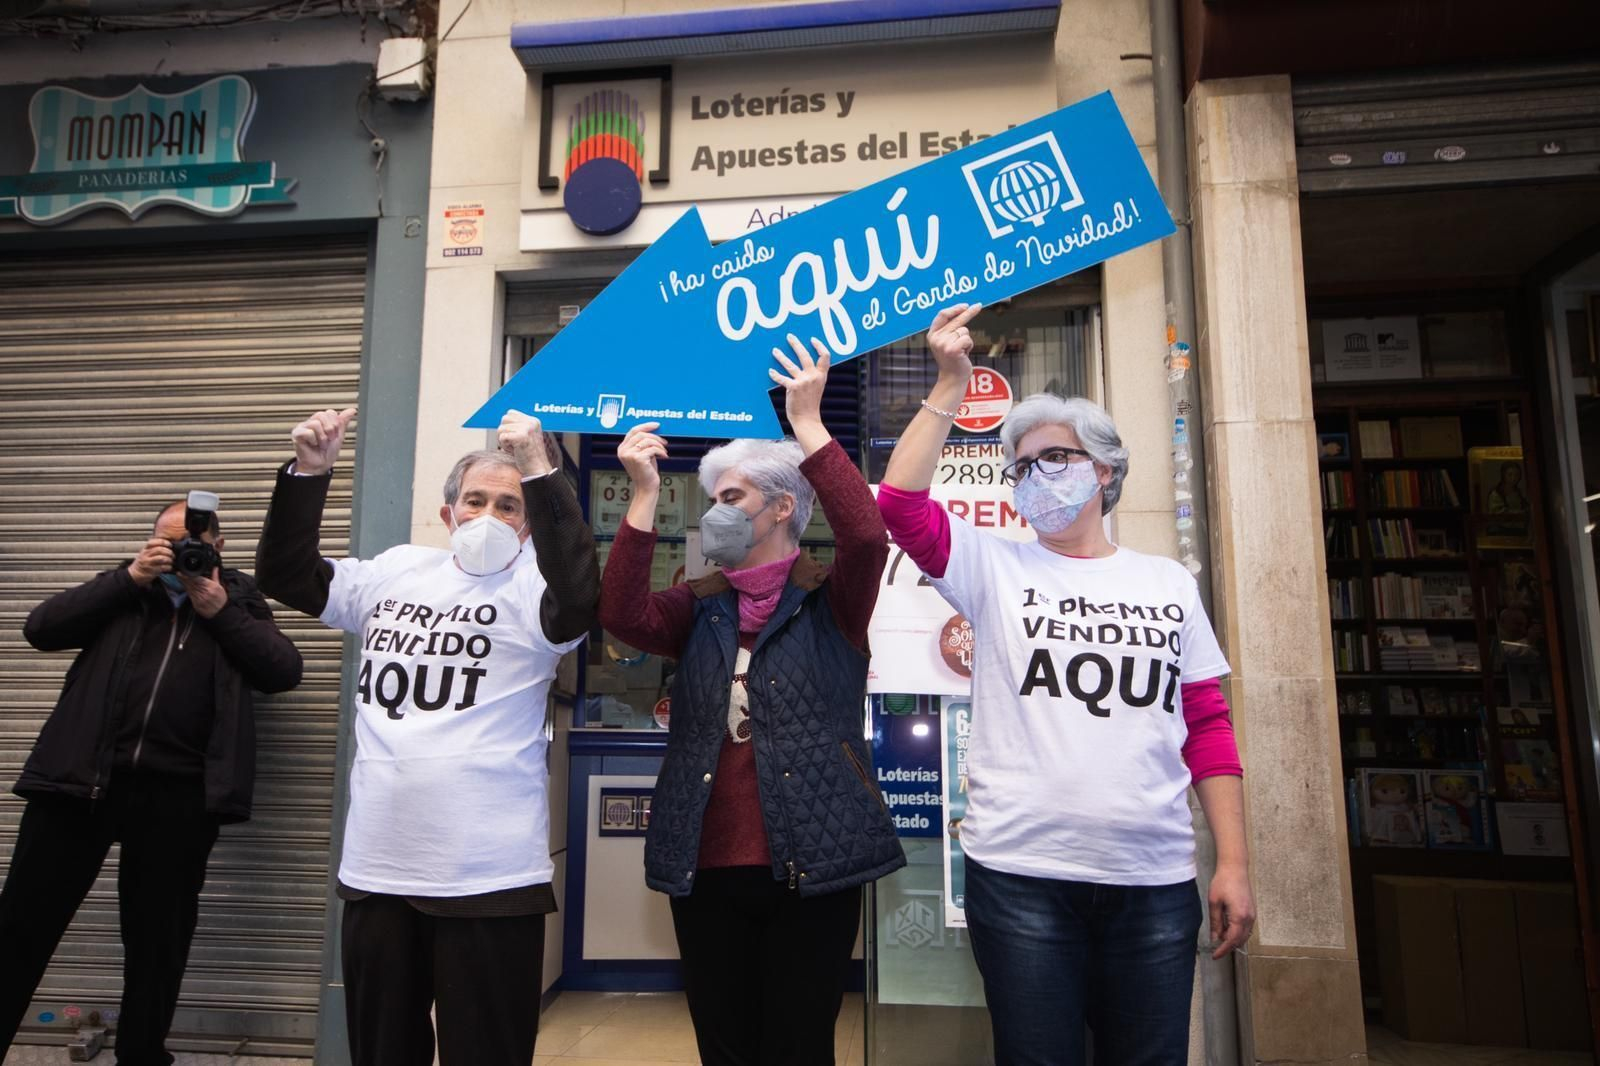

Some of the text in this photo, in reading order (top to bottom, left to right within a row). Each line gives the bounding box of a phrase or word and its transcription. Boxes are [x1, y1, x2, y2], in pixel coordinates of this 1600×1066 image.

[691, 87, 856, 121] Loterías y
[67, 110, 206, 161] MOMPAN
[691, 138, 847, 177] Apuestas
[857, 131, 908, 161] del
[78, 169, 188, 189] PANADERIAS
[716, 186, 940, 356] aquí
[862, 197, 1143, 331] el Gordo de Navidad!
[534, 402, 754, 422] Loterías y Apuestas del Estado
[947, 499, 1028, 528] REM
[1022, 616, 1182, 657] VENDIDO
[358, 661, 487, 720] AQUÍ
[1019, 648, 1181, 718] AQUÍ
[877, 766, 939, 782] Loterías
[892, 813, 930, 829] tado
